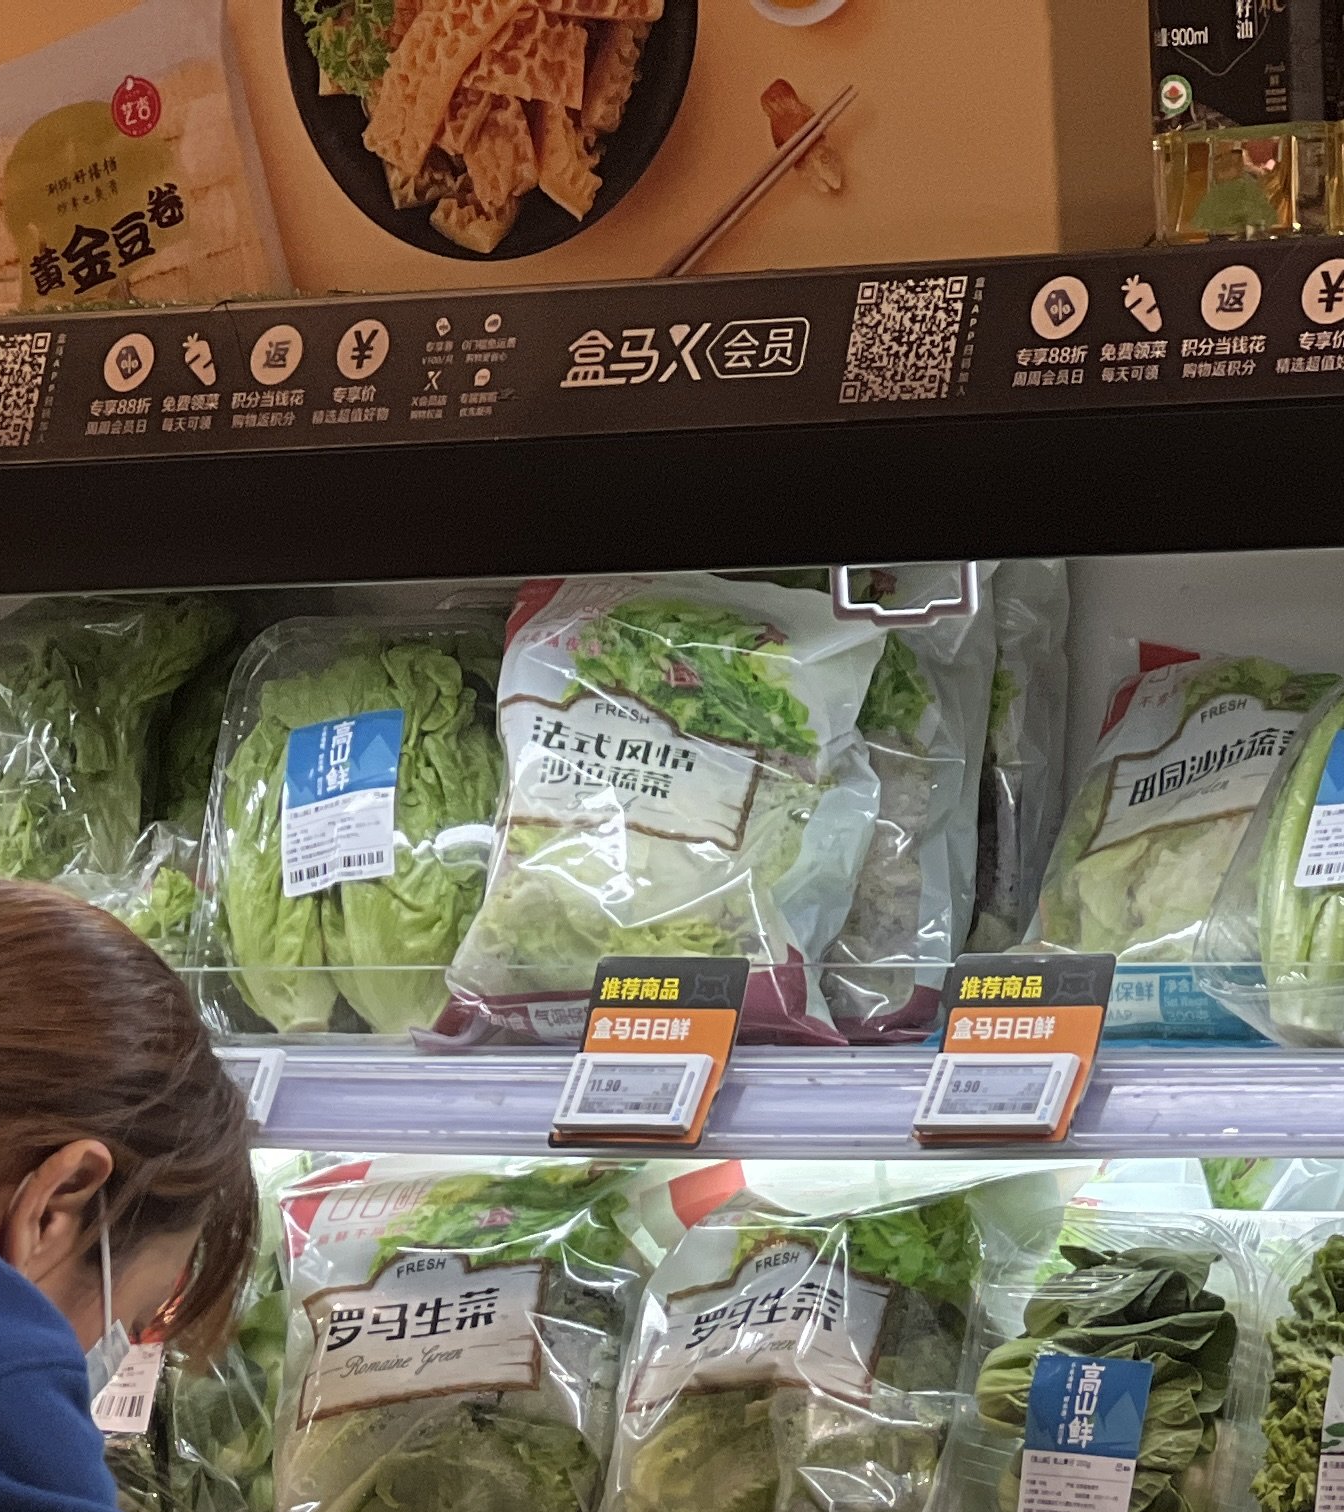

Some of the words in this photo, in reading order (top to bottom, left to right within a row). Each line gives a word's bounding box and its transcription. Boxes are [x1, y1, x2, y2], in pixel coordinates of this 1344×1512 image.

[1016, 344, 1088, 366] 专享88折
[1099, 340, 1168, 362] 免费领菜
[1181, 335, 1267, 358] 积分当钱花
[1011, 368, 1084, 388] 周周会员日
[1101, 364, 1160, 384] 每天可领
[1181, 359, 1256, 379] 购物返积分
[161, 393, 221, 414] 免费领菜
[231, 389, 305, 410] 积分当钱花
[332, 384, 377, 405] 专享价
[89, 397, 152, 417] 专享88折
[594, 701, 651, 725] FRESH
[1199, 697, 1248, 723] FRESH
[531, 715, 697, 772] 法式风情
[325, 721, 355, 793] 高山鲜
[540, 756, 674, 799] 沙拉蔬菜
[600, 977, 680, 1000] 推荐商品
[959, 975, 1043, 1000] 推荐商品
[591, 1016, 691, 1041] 盒马日日鲜
[951, 1015, 1056, 1041] 盒马日日鲜
[396, 1257, 447, 1278] FRESH
[755, 1251, 800, 1273] FRESH
[326, 1287, 501, 1352] 罗马生菜
[340, 1355, 412, 1378] Romaine
[414, 1345, 463, 1375] Green
[1067, 1362, 1106, 1449] 高山鲜
